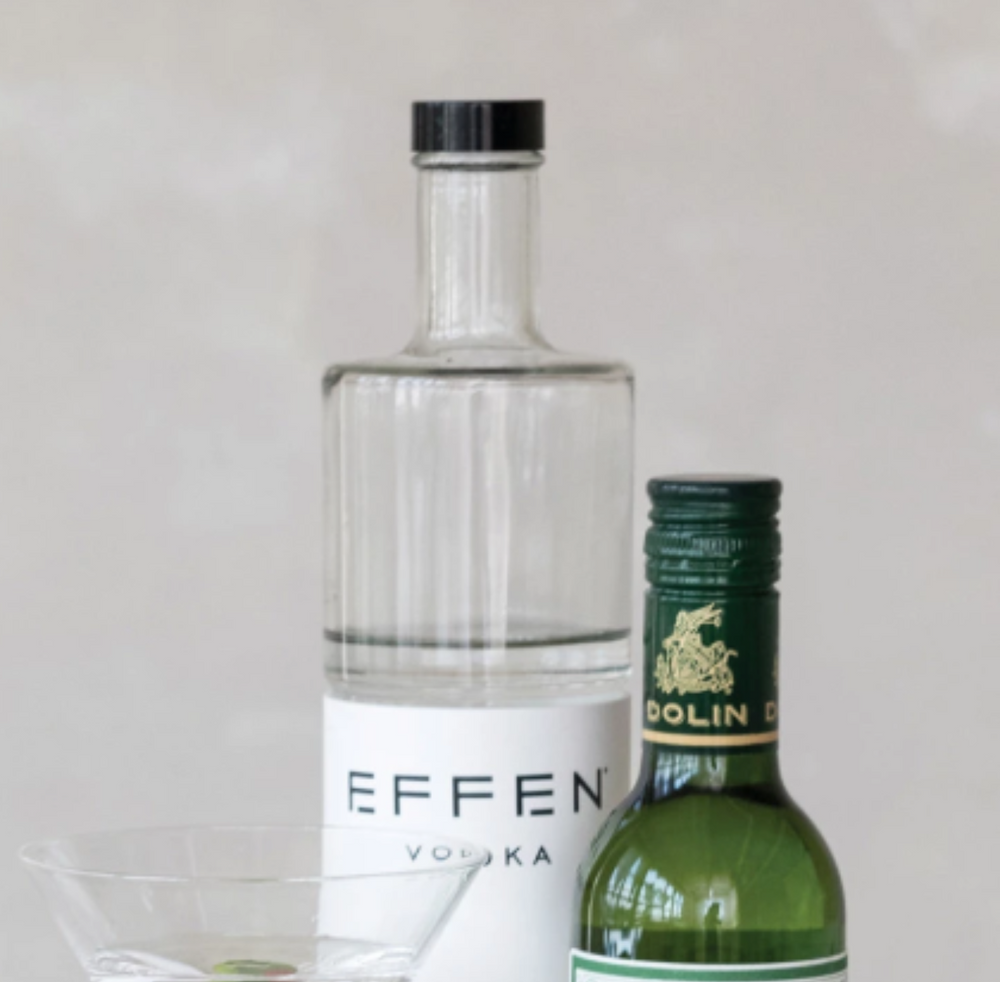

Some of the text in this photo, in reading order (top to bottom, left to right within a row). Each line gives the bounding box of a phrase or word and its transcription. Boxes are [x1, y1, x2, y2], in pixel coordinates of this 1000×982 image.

[647, 699, 749, 727] DOLIN
[348, 767, 604, 817] EFFEN
[406, 845, 552, 866] VODKA
